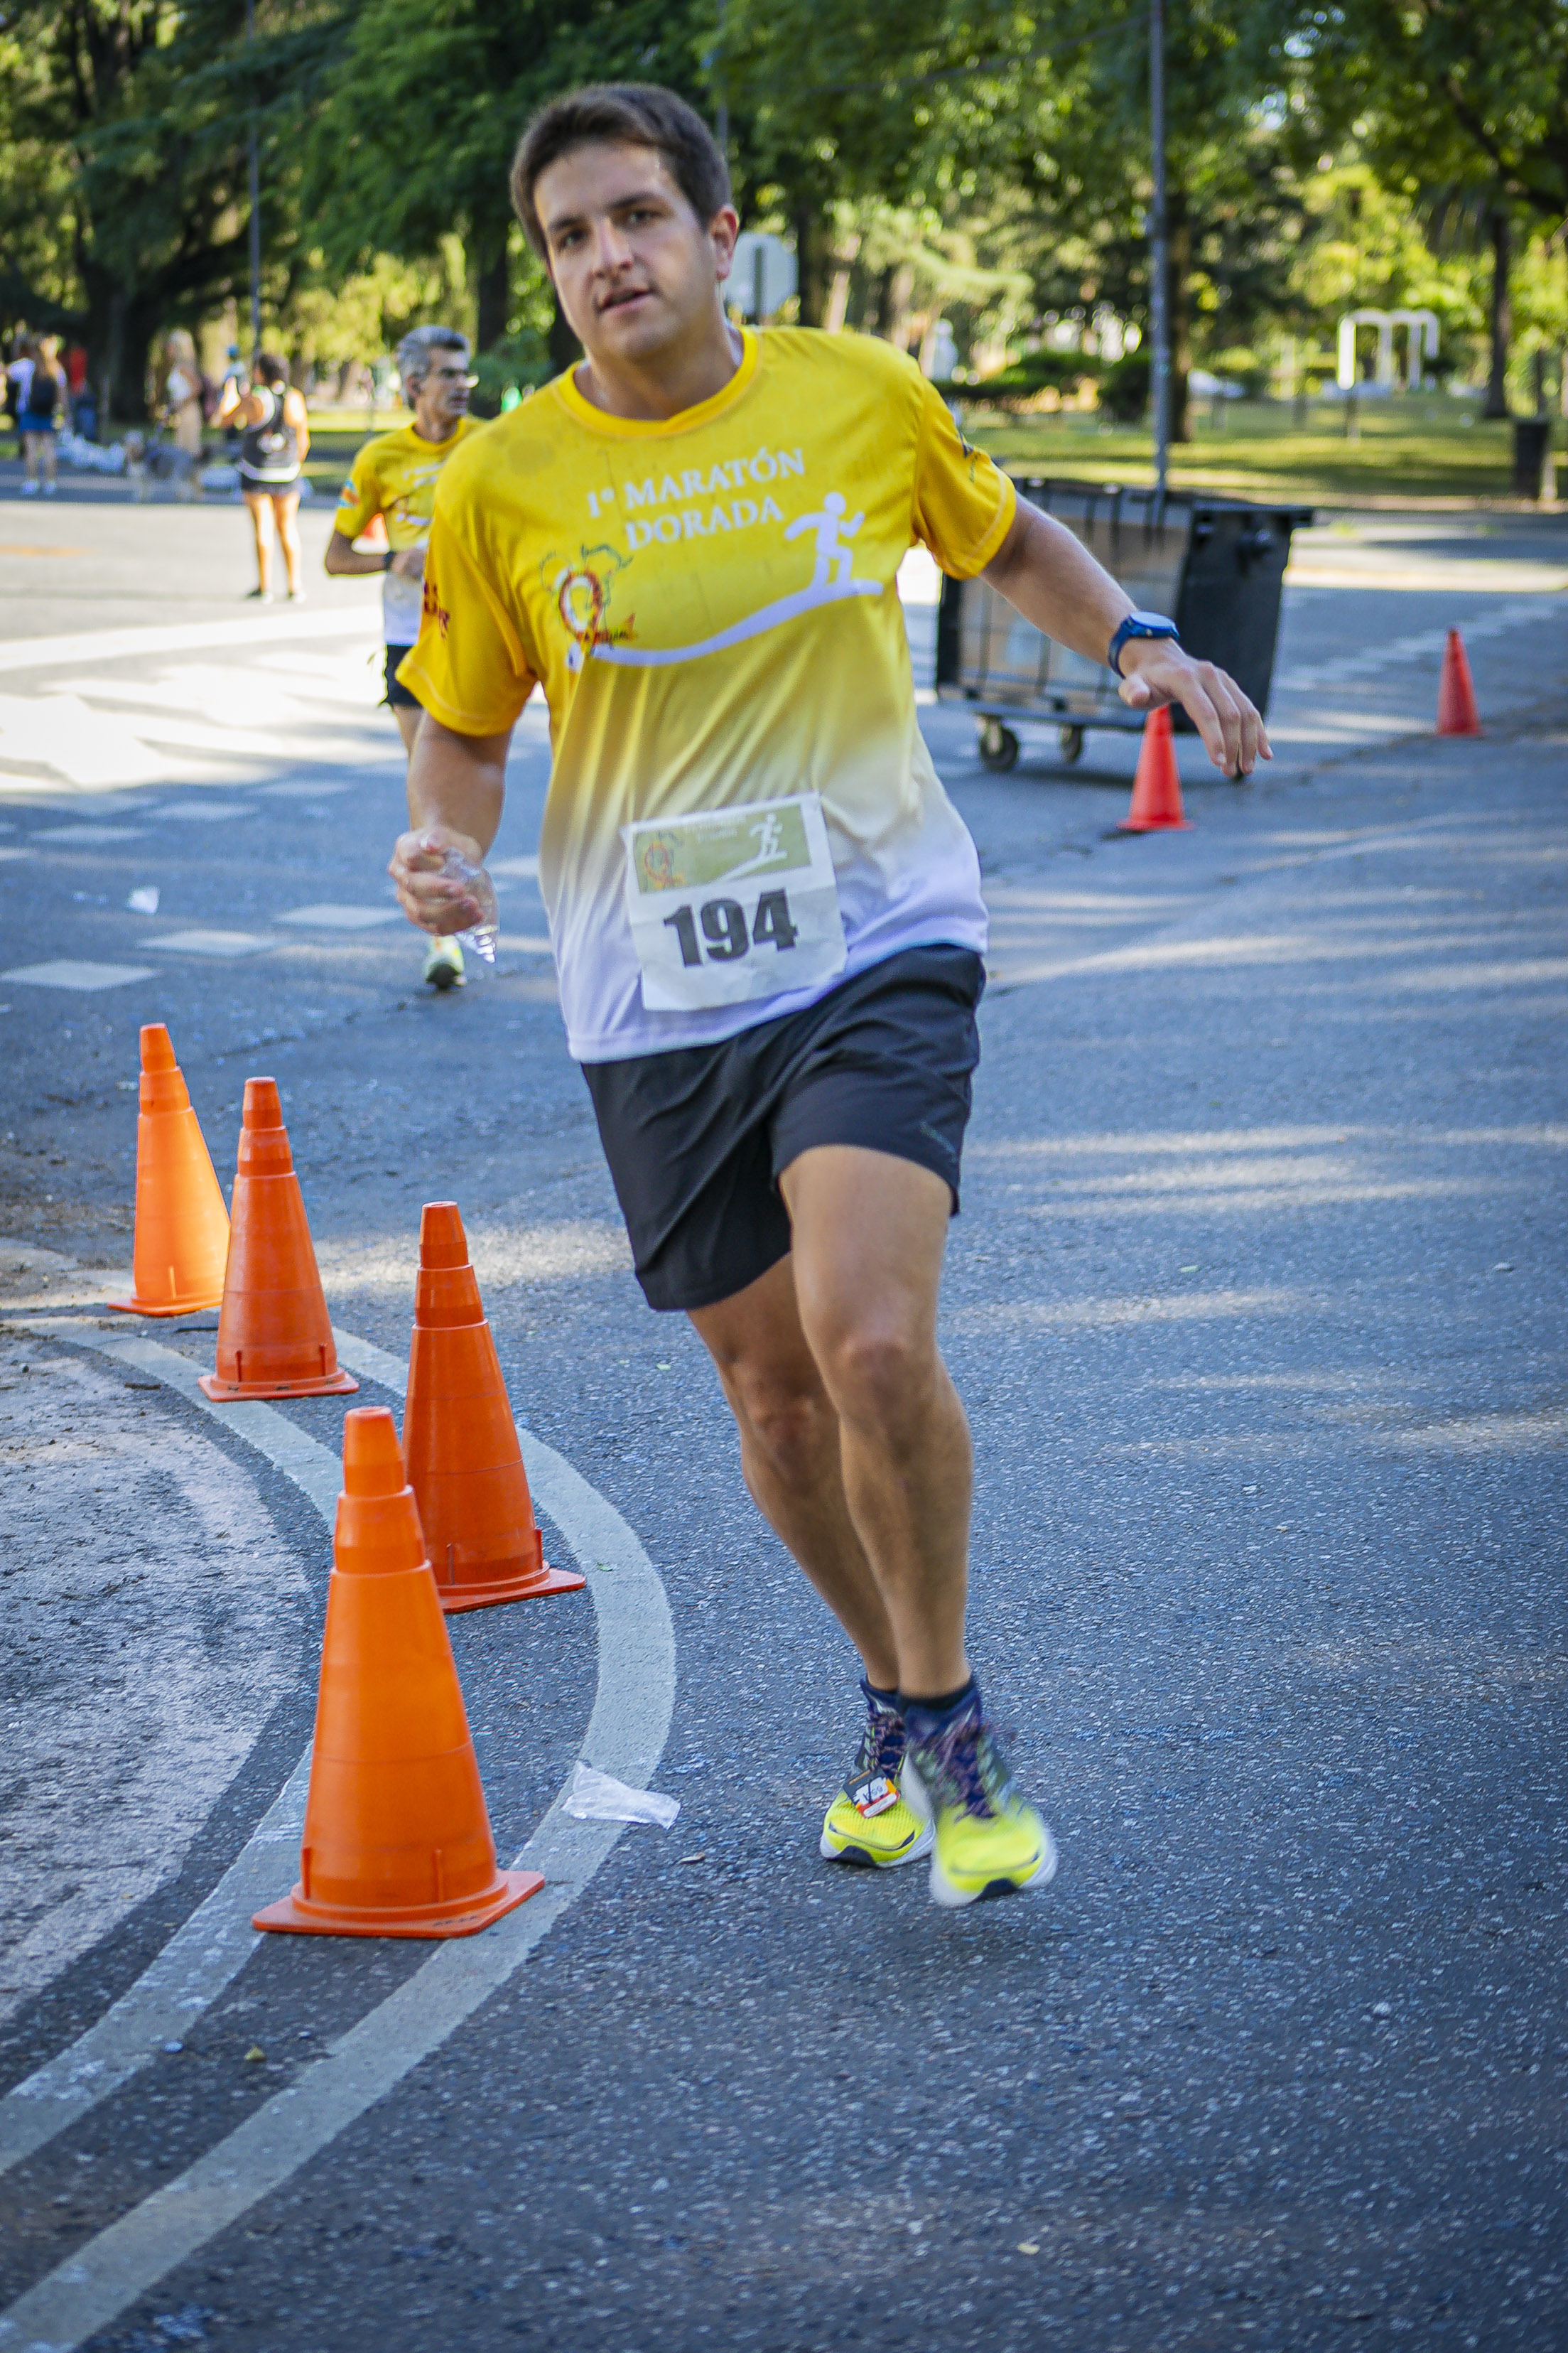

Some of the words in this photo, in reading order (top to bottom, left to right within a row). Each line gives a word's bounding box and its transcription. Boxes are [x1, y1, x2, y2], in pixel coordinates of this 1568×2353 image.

[624, 446, 805, 510] MARATÓN
[626, 495, 784, 549] DORADA
[662, 888, 799, 968] 194
